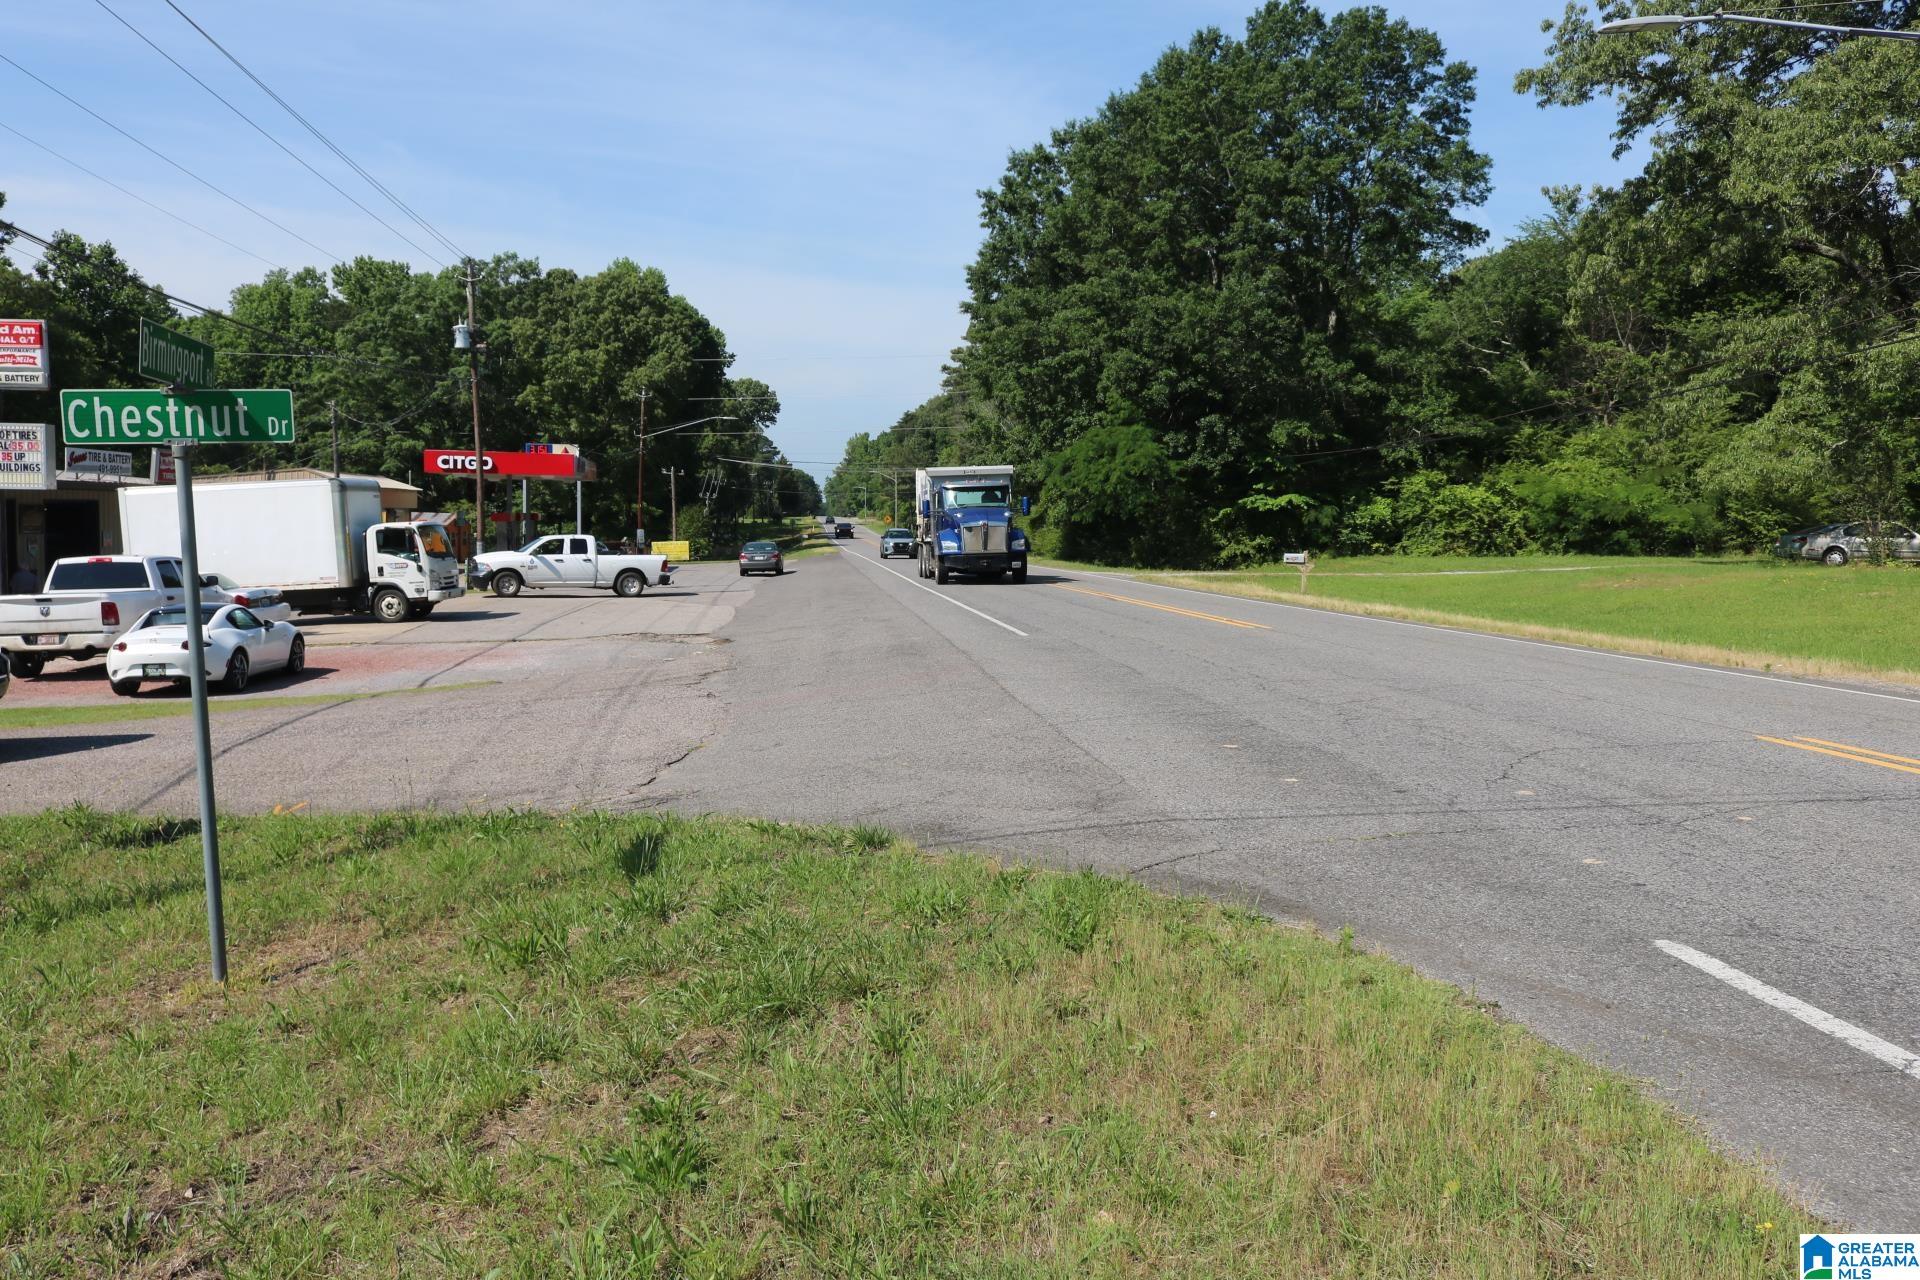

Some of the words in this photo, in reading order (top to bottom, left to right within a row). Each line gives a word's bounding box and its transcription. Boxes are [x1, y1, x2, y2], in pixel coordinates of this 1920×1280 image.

[0, 336, 17, 344] IAL
[142, 325, 204, 385] Birmingport
[4, 374, 40, 382] BATTERY
[67, 396, 249, 438] Chestnut
[267, 416, 289, 436] Dr
[0, 430, 11, 440] OF
[12, 430, 38, 440] TIRES
[2, 452, 12, 461] 35
[14, 452, 26, 461] UP
[88, 451, 102, 463] TIRE
[103, 453, 107, 463] &
[108, 453, 131, 465] BATTERY
[436, 454, 493, 470] CITGO
